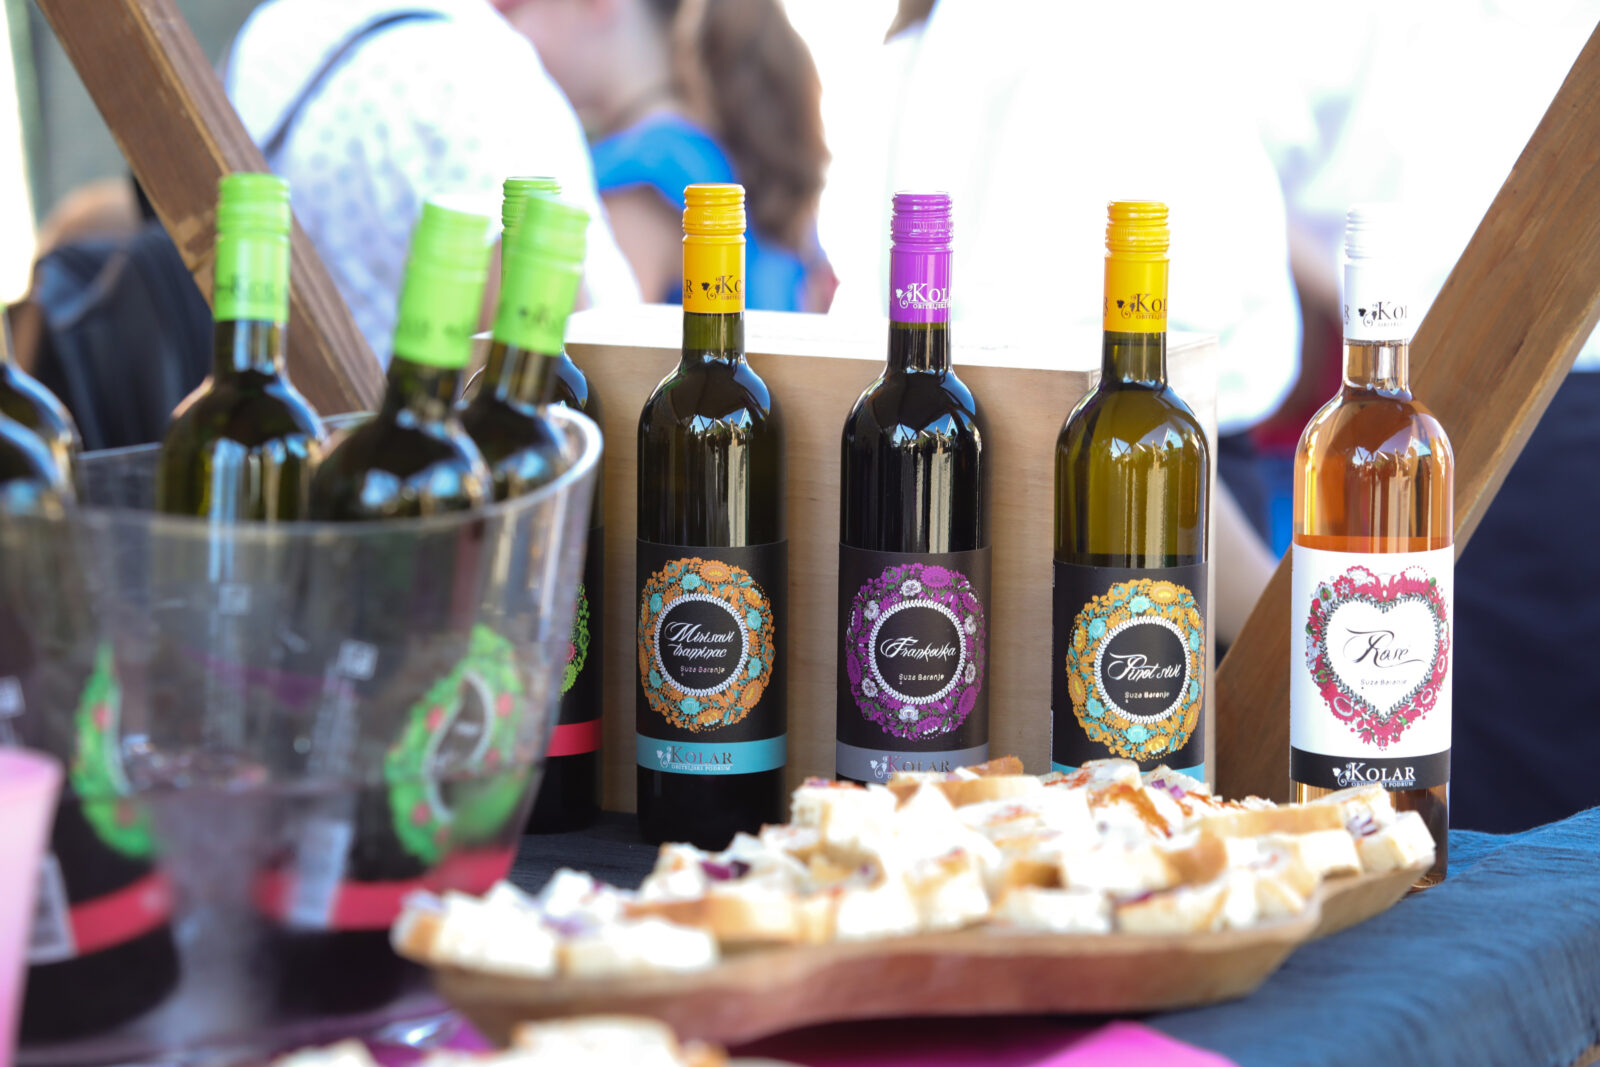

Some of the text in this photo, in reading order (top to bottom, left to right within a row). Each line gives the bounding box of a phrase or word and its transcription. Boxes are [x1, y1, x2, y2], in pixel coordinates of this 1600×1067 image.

[667, 643, 727, 660] traminac
[880, 636, 957, 662] Frankovka
[1107, 652, 1182, 682] Pinot sivi
[671, 745, 733, 765] KOLAR
[1350, 762, 1416, 781] KOLAR
